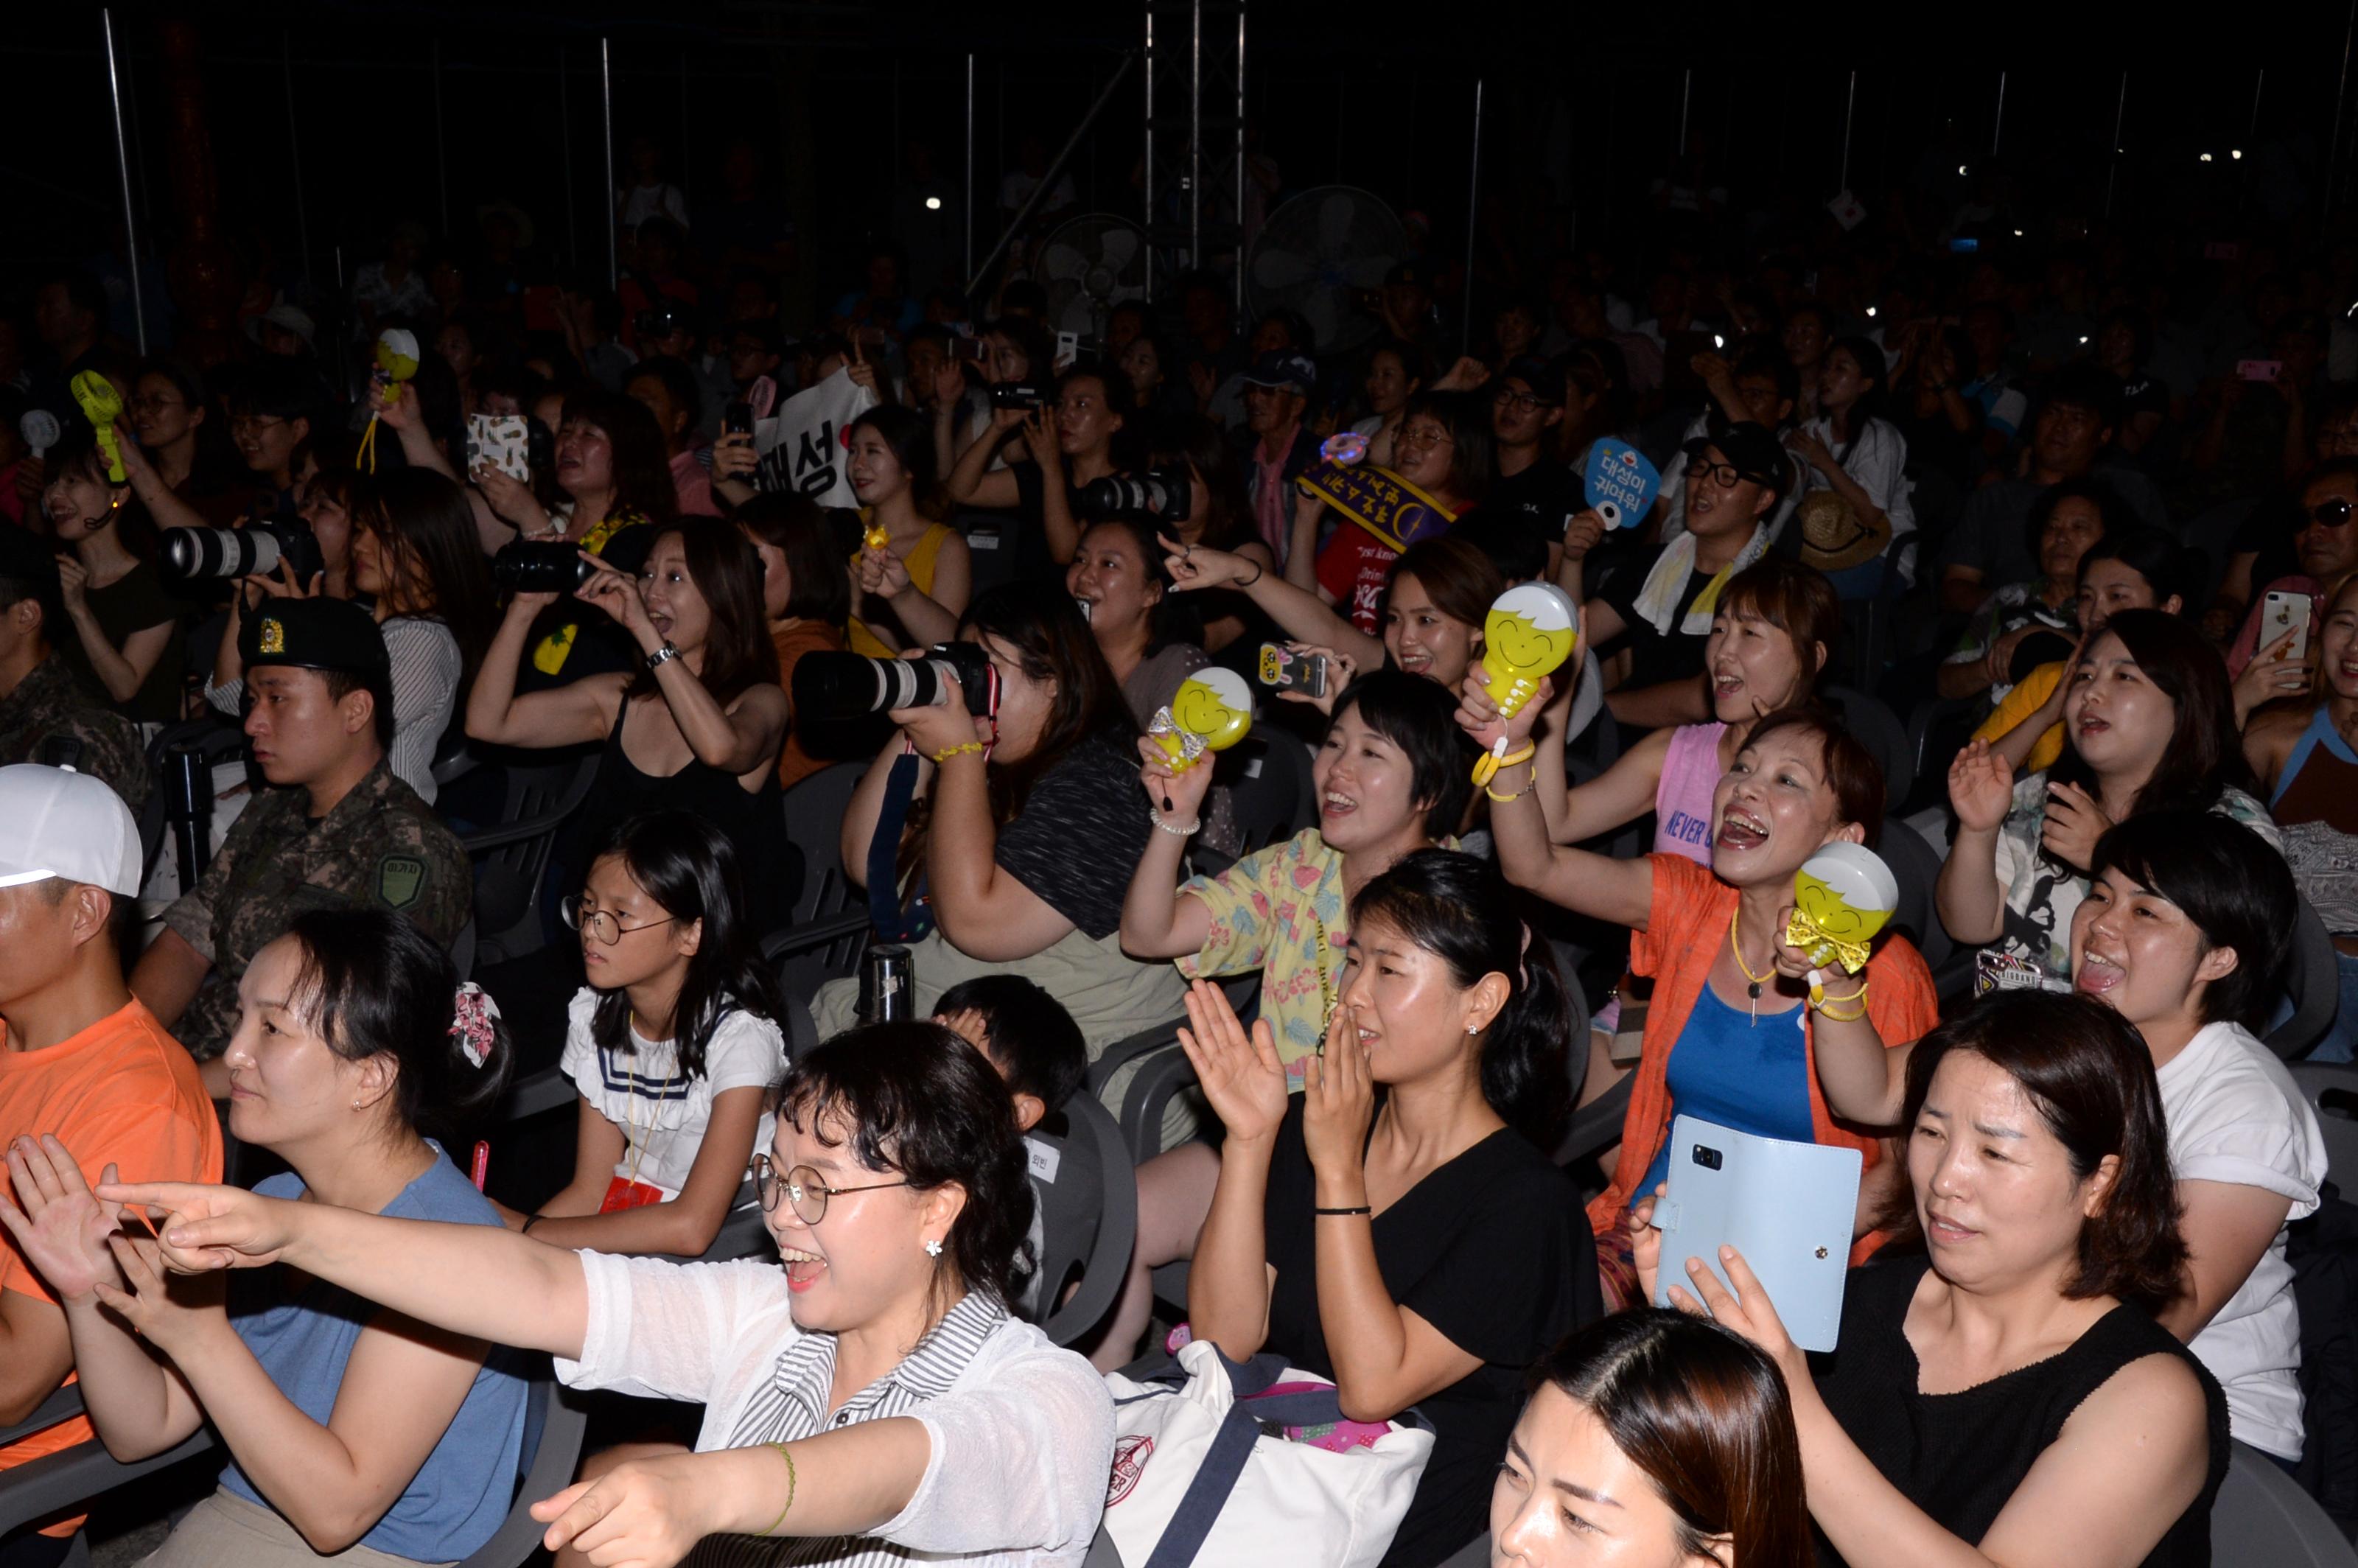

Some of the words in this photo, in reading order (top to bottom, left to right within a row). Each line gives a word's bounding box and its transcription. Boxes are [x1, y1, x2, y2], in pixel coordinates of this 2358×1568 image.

[1600, 455, 1647, 496] 대성이
[1594, 475, 1640, 514] 귀여워
[1665, 810, 1706, 845] NEVER
[2002, 971, 2035, 984] BIGBANG
[1032, 1154, 1048, 1170] 외빈
